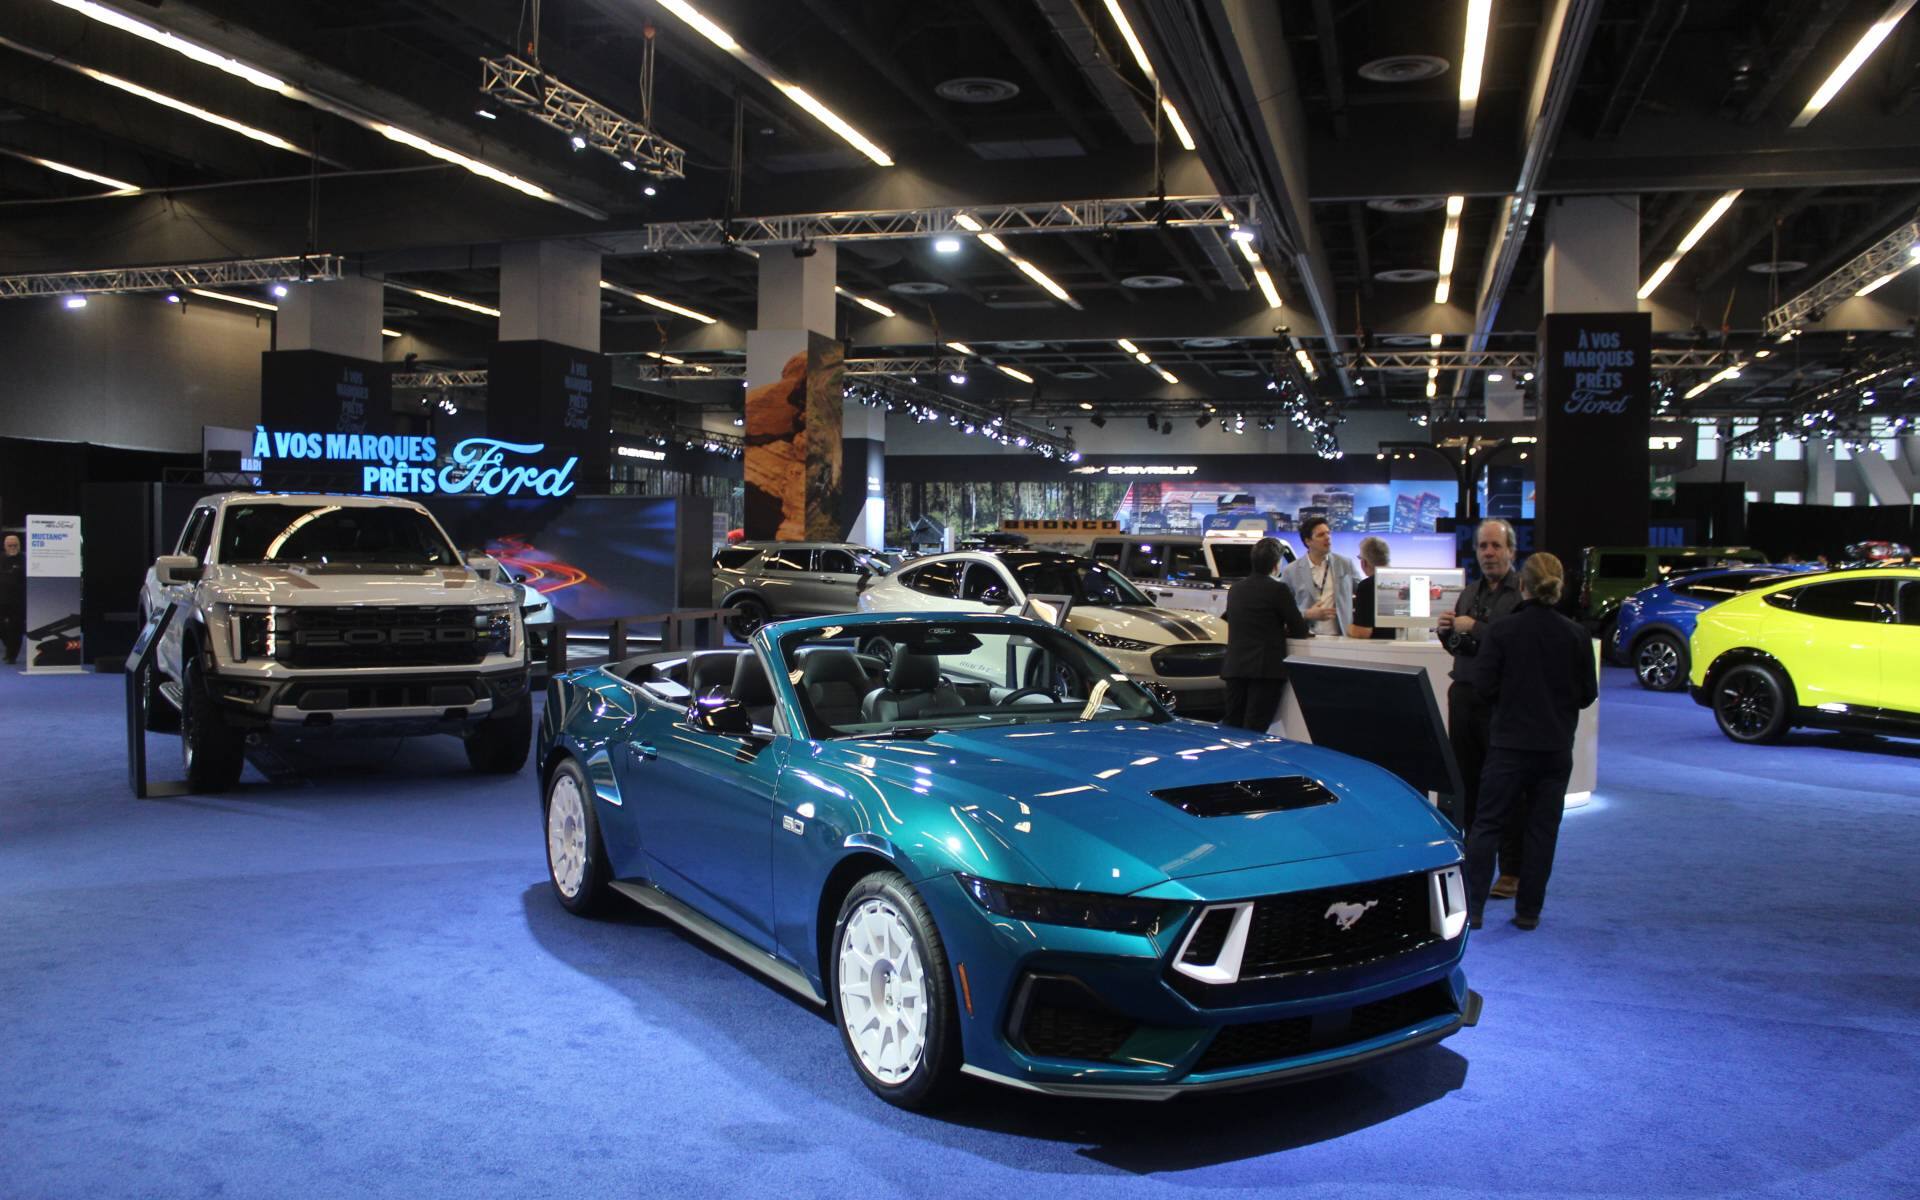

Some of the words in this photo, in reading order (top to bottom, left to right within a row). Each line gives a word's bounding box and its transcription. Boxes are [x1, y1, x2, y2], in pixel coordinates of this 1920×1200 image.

[1578, 327, 1588, 349] À
[1590, 331, 1621, 349] VOS
[1563, 350, 1635, 368] MARQUES
[1575, 368, 1623, 389] PRÊTS
[1562, 388, 1633, 414] Ford
[253, 425, 271, 458] À
[274, 431, 322, 459] VOS
[327, 433, 437, 462] MARQUES
[362, 462, 436, 493] PRÊTS
[438, 437, 578, 496] Ford
[1108, 466, 1198, 475] CHEVROLET
[1005, 520, 1117, 529] BRONCO
[295, 628, 476, 646] FORD
